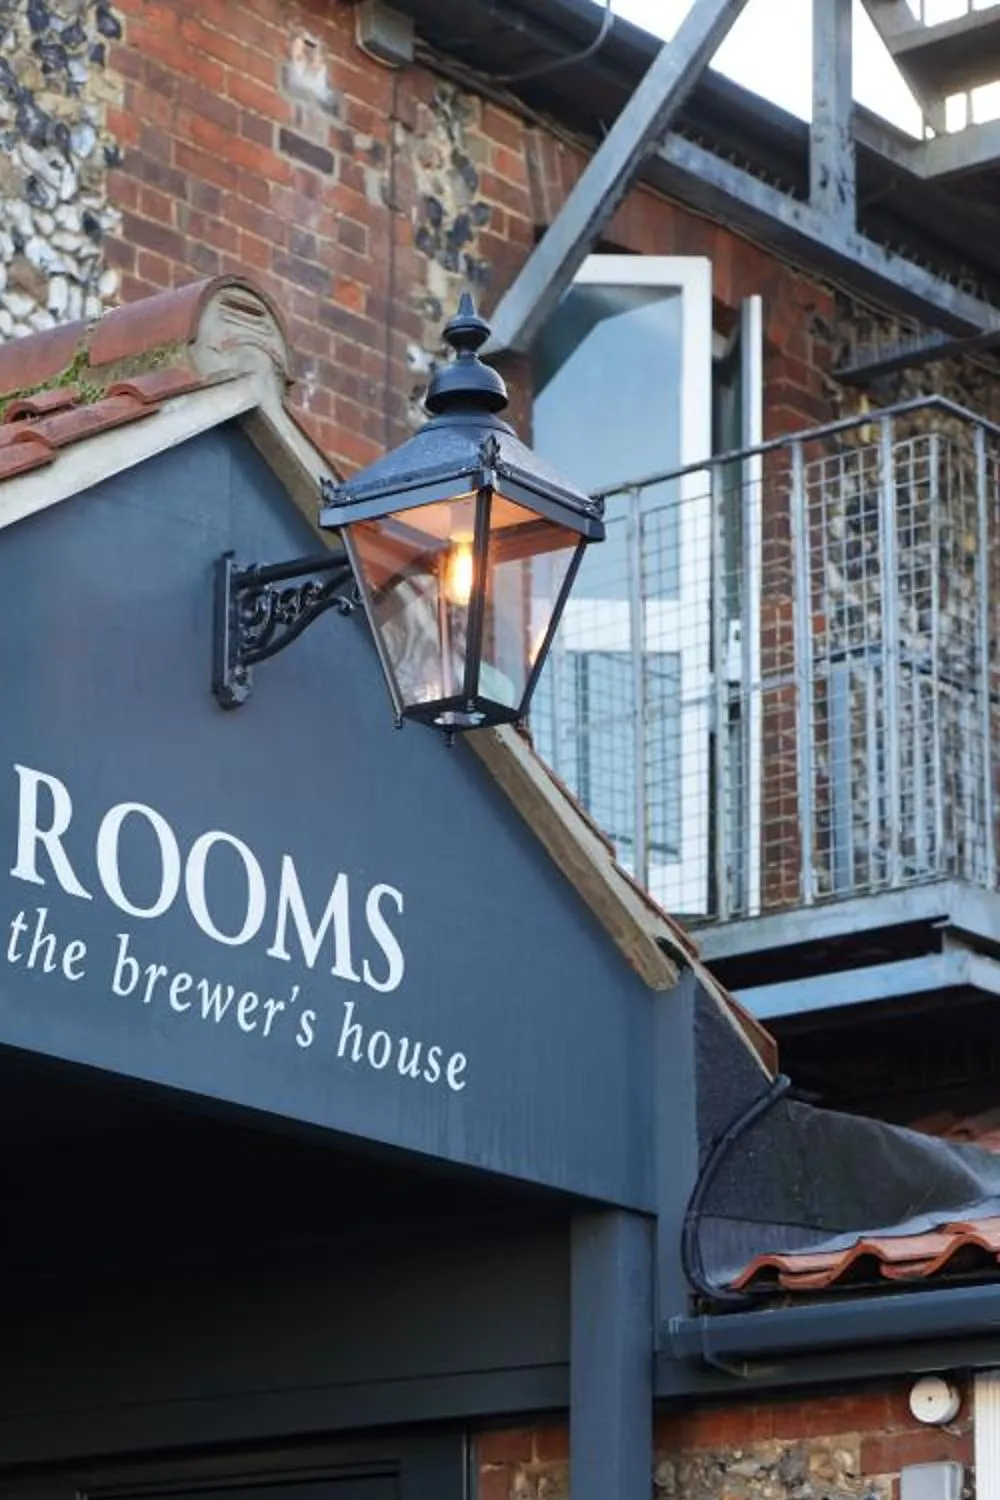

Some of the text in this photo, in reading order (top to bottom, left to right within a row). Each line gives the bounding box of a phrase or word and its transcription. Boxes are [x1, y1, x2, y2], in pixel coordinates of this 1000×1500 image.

[10, 763, 404, 993] ROOMS
[6, 908, 87, 981] the
[112, 934, 316, 1048] brewer's
[337, 1002, 467, 1091] house
